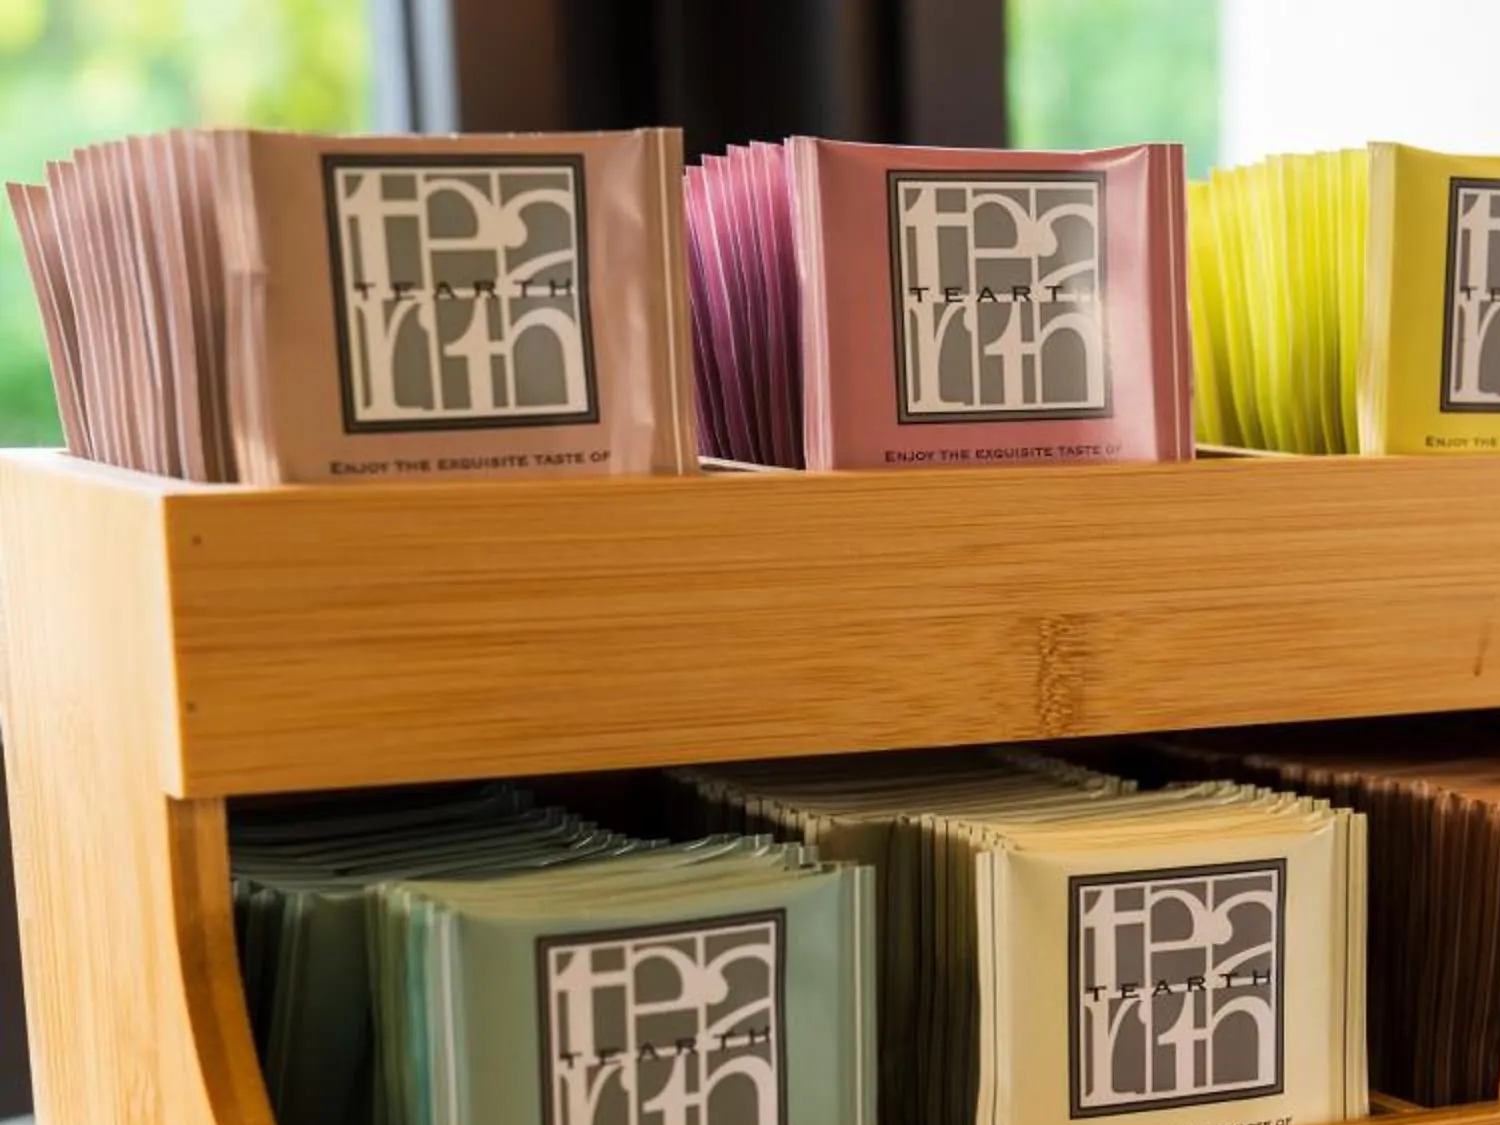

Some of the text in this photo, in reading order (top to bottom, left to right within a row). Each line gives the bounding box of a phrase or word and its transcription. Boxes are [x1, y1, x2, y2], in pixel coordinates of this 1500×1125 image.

[353, 280, 575, 301] TEARTH
[909, 285, 1094, 303] TEART
[395, 460, 431, 473] THE
[437, 455, 529, 471] EXQUISITE
[533, 452, 585, 466] TASTE
[589, 450, 612, 464] OF
[885, 450, 934, 463] ENJOY
[940, 449, 971, 461] THE
[975, 446, 1053, 460] EXQUISITE
[1058, 445, 1101, 457] TASTE
[1085, 970, 1271, 1002] TEARTH
[559, 1024, 771, 1069] TEARTH
